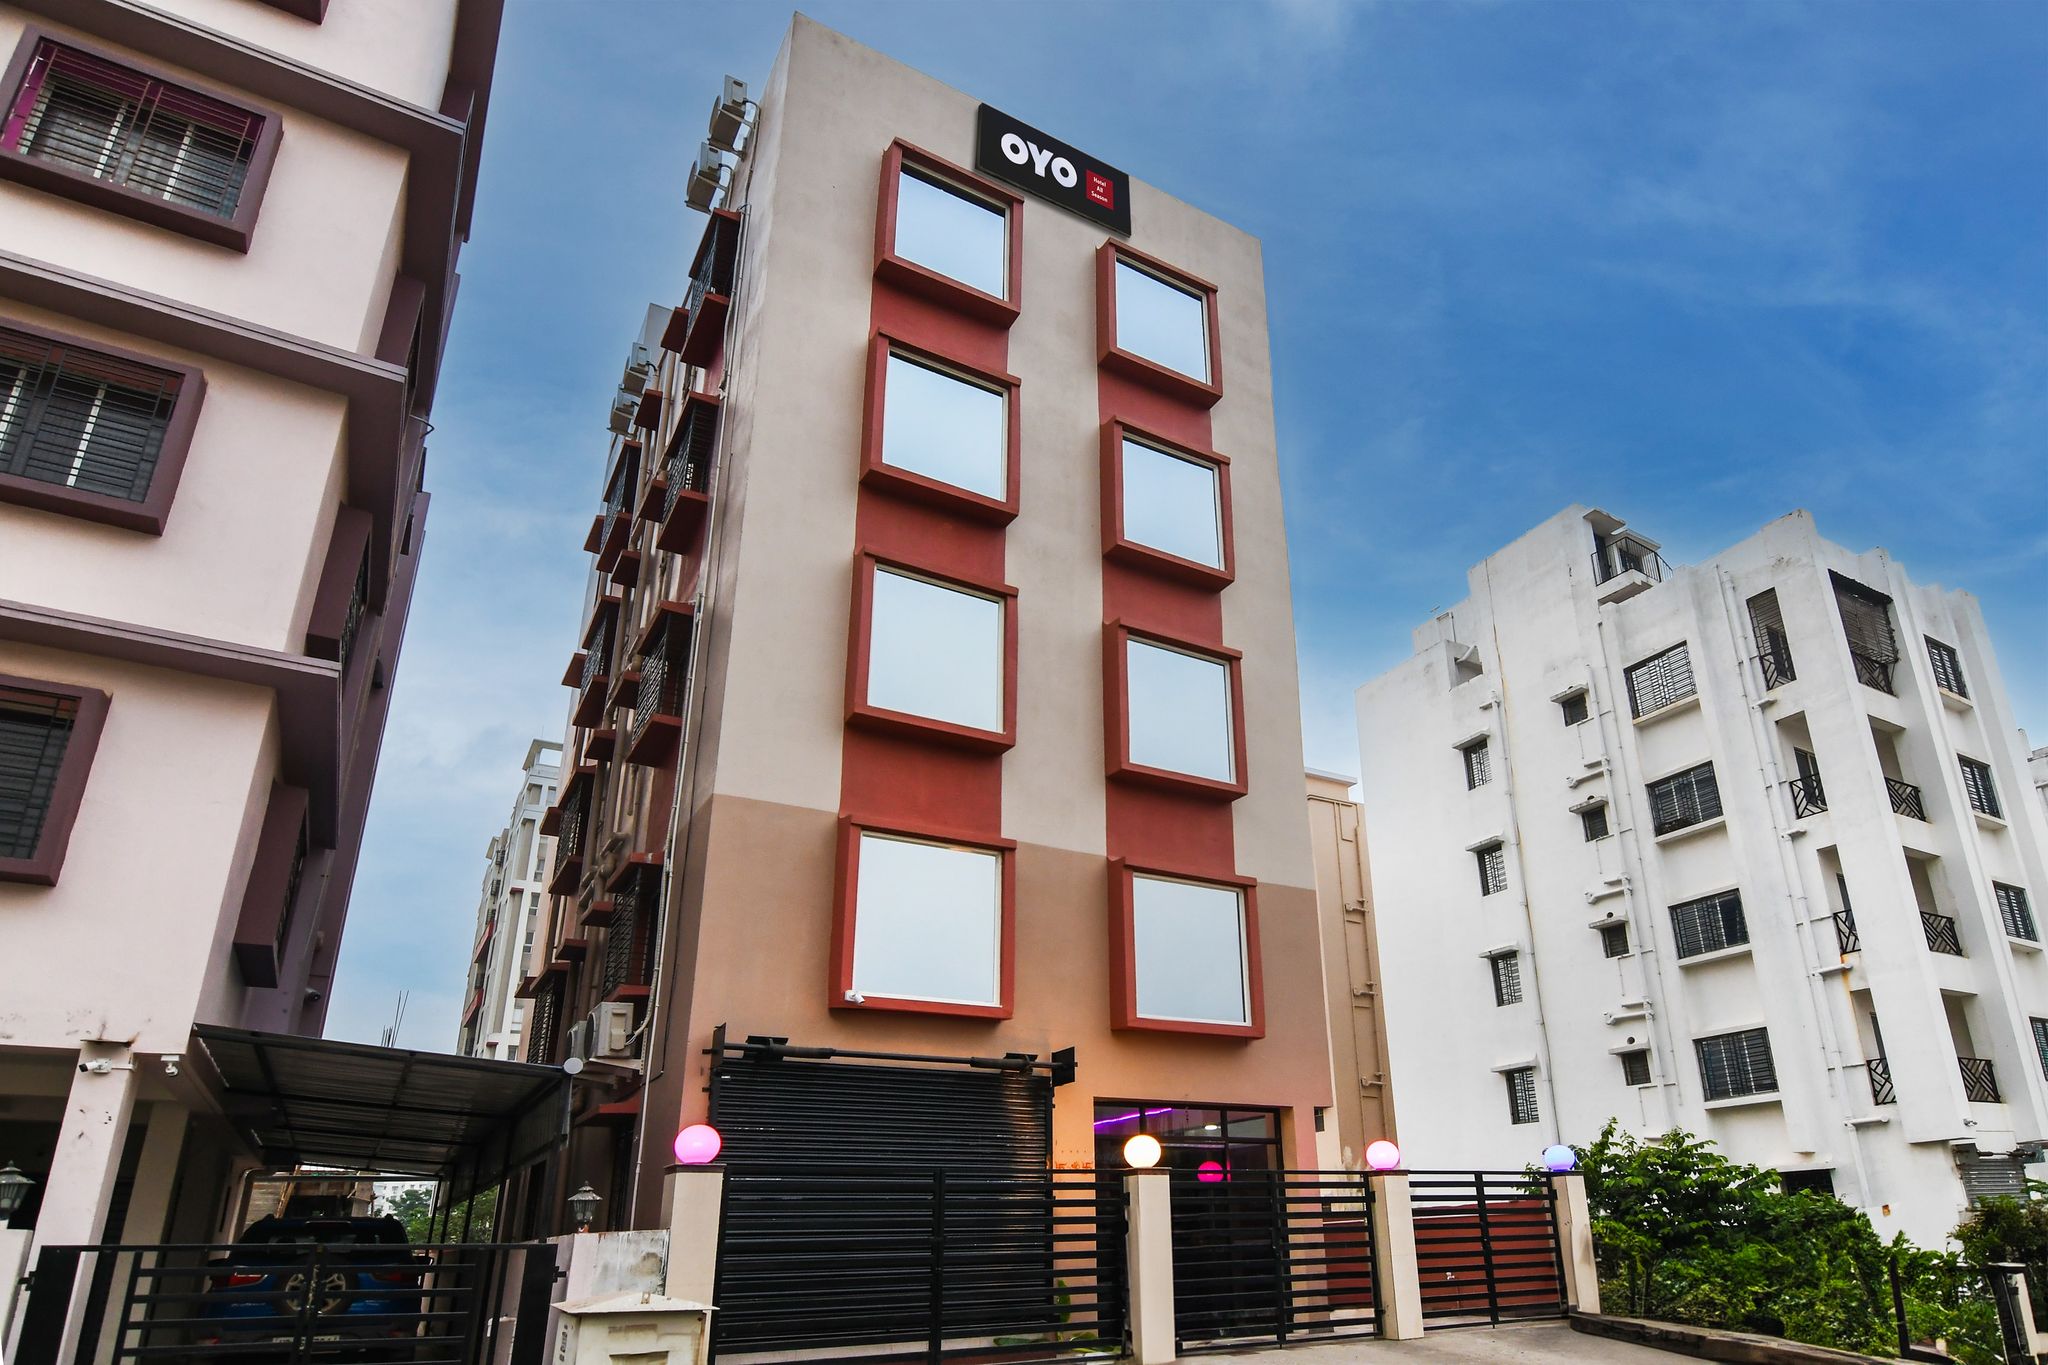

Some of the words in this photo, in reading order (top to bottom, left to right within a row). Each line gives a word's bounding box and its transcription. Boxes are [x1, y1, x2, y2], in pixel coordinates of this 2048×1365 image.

[1001, 133, 1078, 188] OYO
[1093, 176, 1107, 187] Hotel
[1091, 190, 1108, 203] Season
